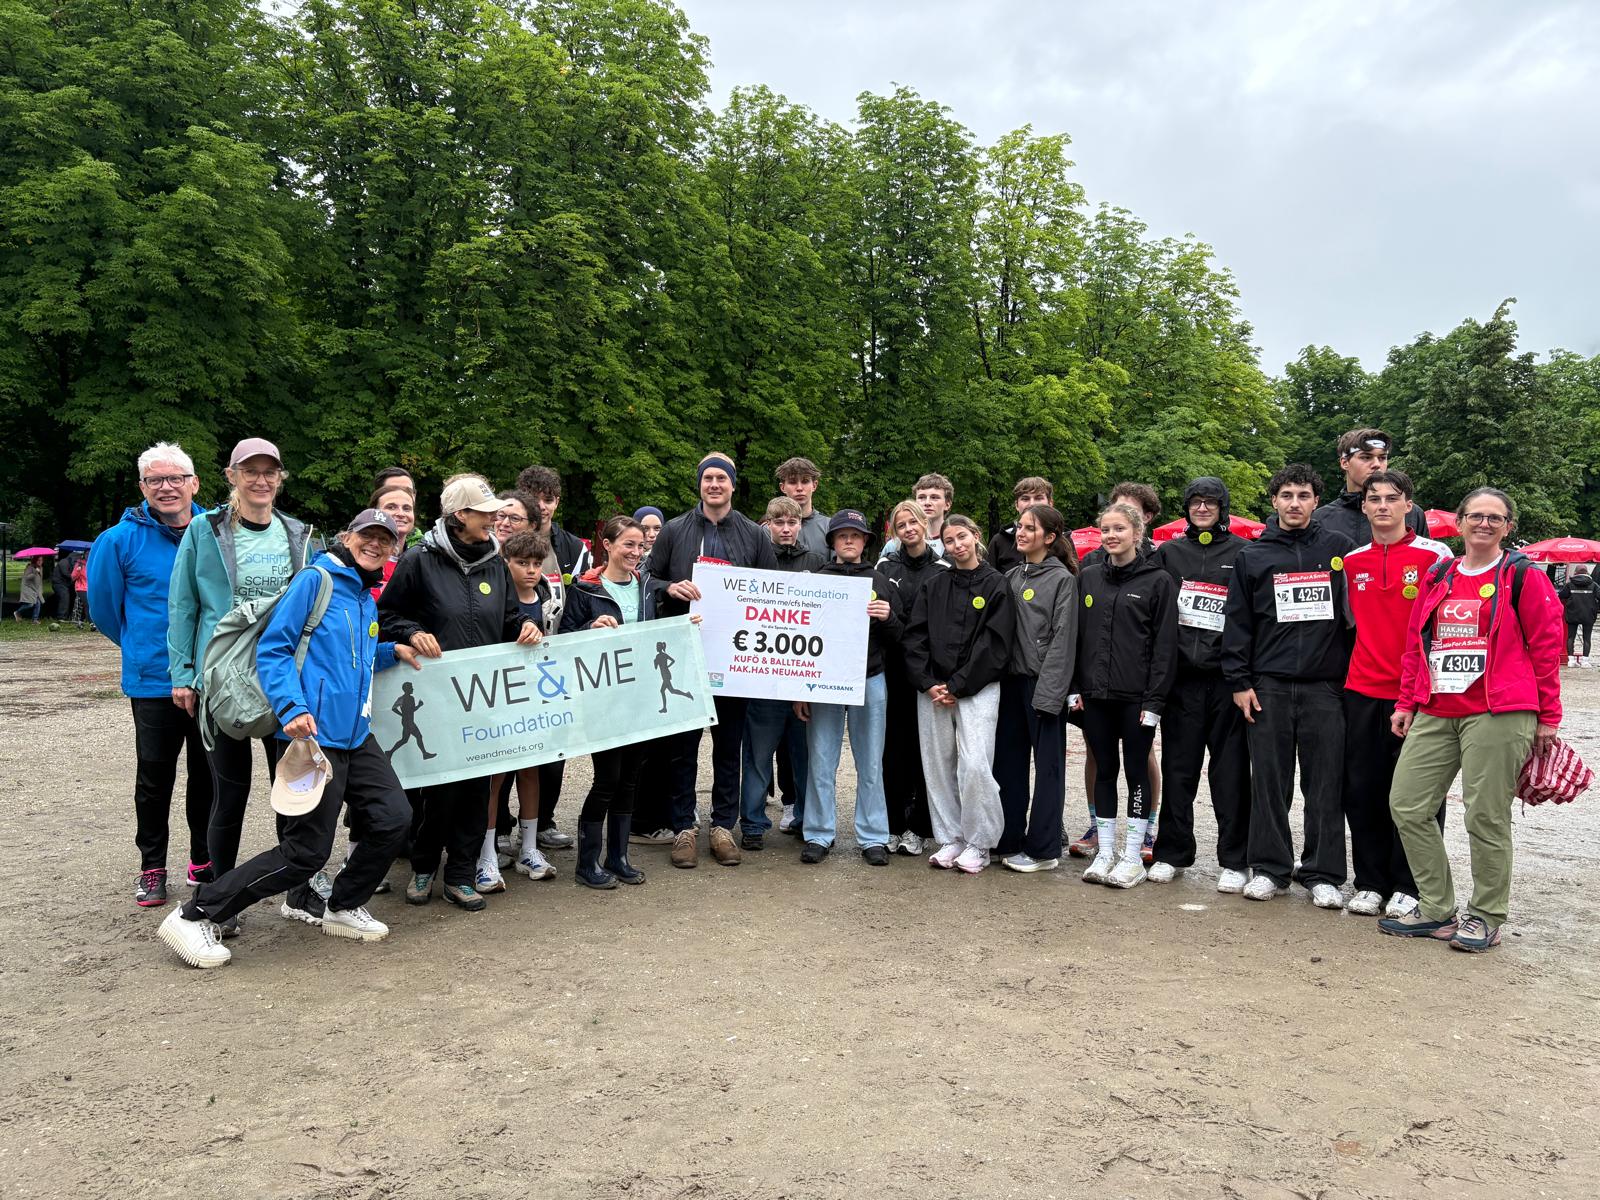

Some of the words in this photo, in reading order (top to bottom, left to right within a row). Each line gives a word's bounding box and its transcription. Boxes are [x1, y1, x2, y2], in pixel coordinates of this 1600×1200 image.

[373, 509, 387, 523] LA
[245, 553, 288, 564] SCHRITT
[723, 578, 747, 592] WE
[749, 579, 759, 594] &
[762, 581, 785, 595] ME
[787, 587, 849, 600] Foundation
[1298, 588, 1325, 601] 4257
[737, 595, 777, 605] Gemeinsam
[777, 599, 801, 608] me/cfs
[801, 601, 822, 609] heilen
[1197, 597, 1224, 613] 4262
[745, 606, 811, 625] DANKE
[1440, 626, 1474, 634] HAK.HAS
[732, 629, 750, 651] €
[753, 631, 824, 657] 3.000
[734, 654, 759, 664] KUFÖ
[761, 656, 768, 665] &
[770, 658, 815, 668] BALLTEAM
[1446, 656, 1479, 672] 4304
[729, 664, 770, 675] HAK.HAS
[771, 668, 823, 679] NEUMARKT
[450, 665, 530, 712] WE
[537, 657, 569, 701] &
[574, 648, 635, 692] ME
[818, 684, 854, 692] VOLKSBANK
[461, 711, 574, 743] Foundation
[465, 741, 544, 762] weandmecfs.org
